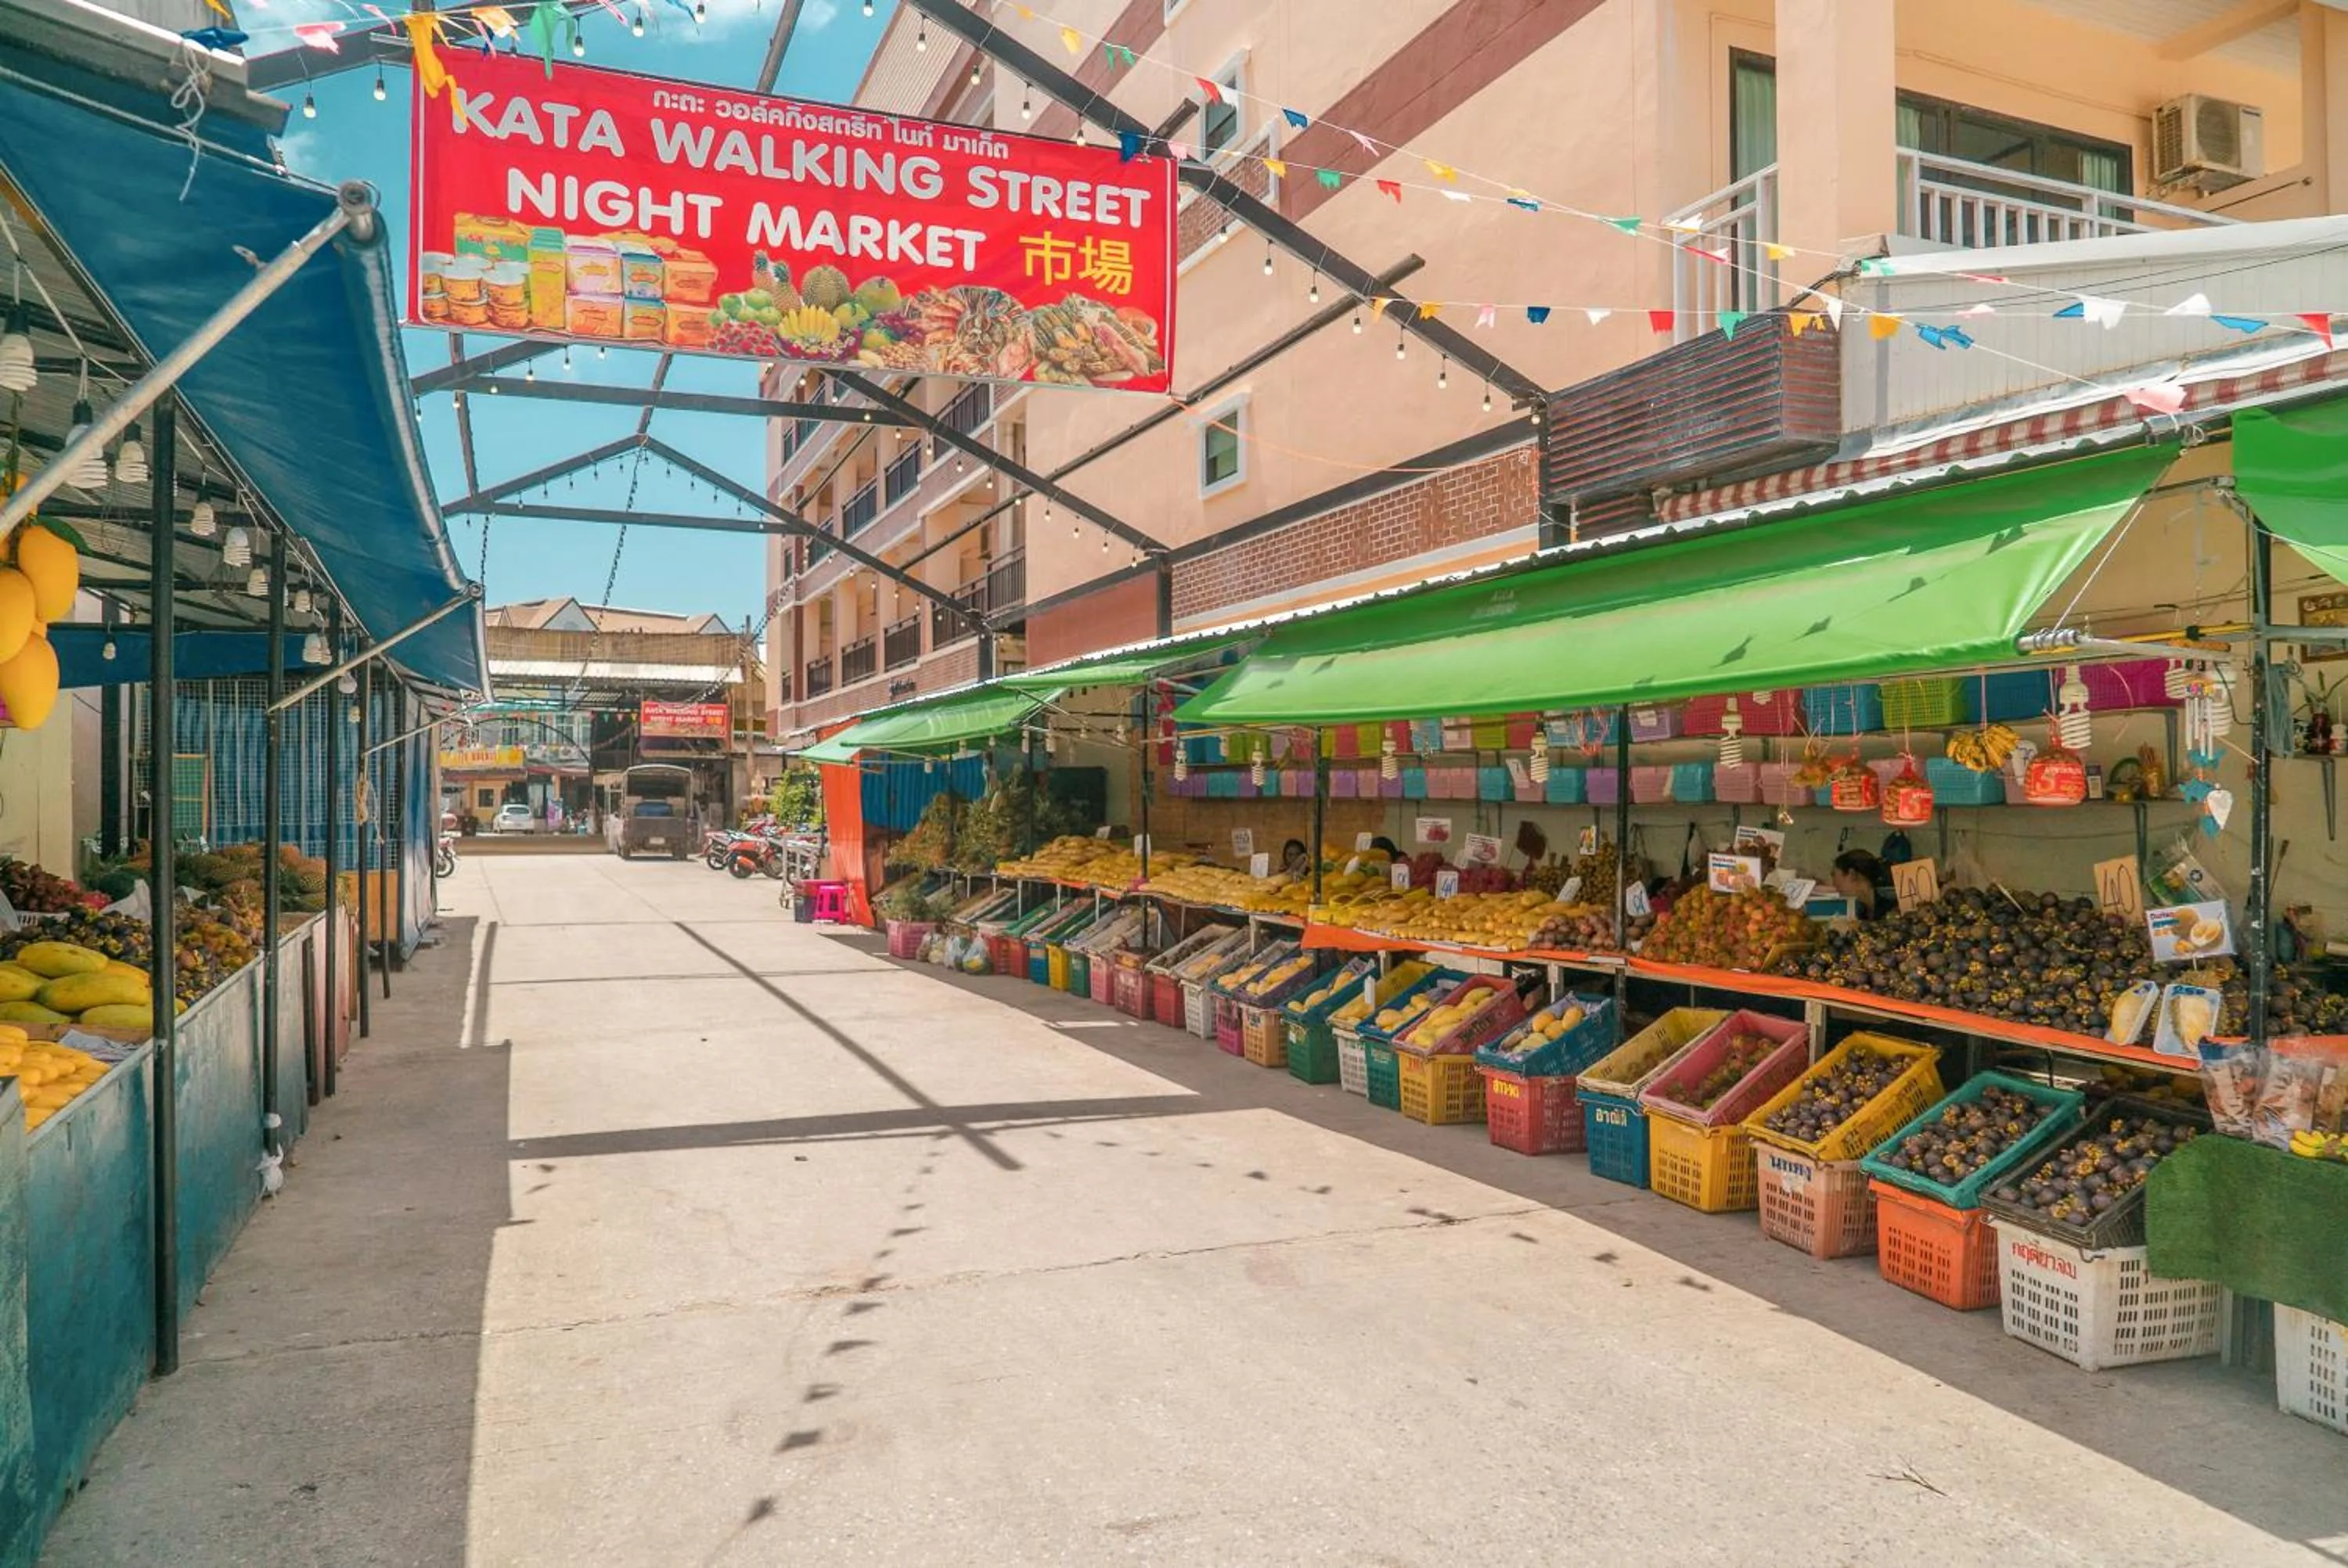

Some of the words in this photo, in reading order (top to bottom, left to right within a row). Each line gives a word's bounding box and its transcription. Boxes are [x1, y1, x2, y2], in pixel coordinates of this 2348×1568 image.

[452, 87, 625, 157] KATA
[650, 118, 943, 200] WALKING
[967, 165, 1151, 228] STREET
[507, 167, 723, 239] NIGHT
[746, 200, 987, 272] MARKET
[1019, 231, 1134, 296] 市場
